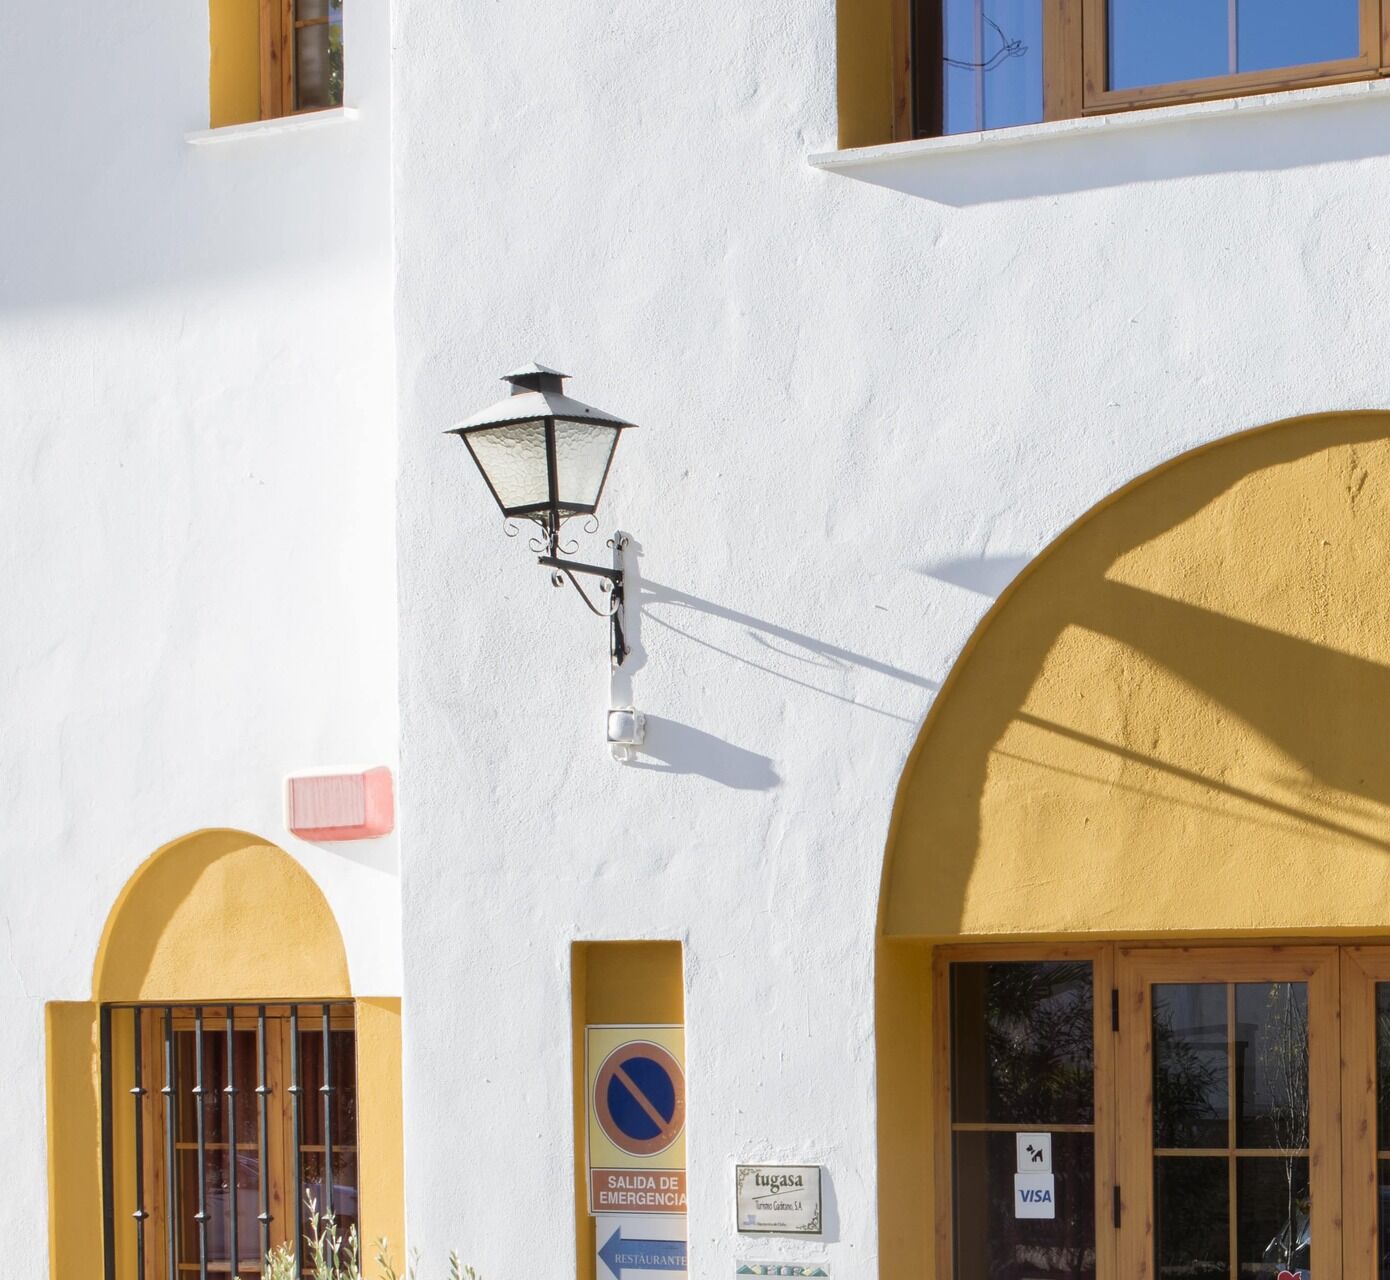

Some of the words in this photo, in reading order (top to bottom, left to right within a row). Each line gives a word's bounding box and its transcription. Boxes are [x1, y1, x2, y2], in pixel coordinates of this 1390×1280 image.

[608, 1176, 656, 1189] SALIDA
[660, 1177, 679, 1189] DE
[755, 1172, 803, 1193] tugasa
[600, 1191, 687, 1205] EMERGENCIA
[1018, 1190, 1052, 1203] VISA
[615, 1254, 687, 1265] RESTAURANTE
